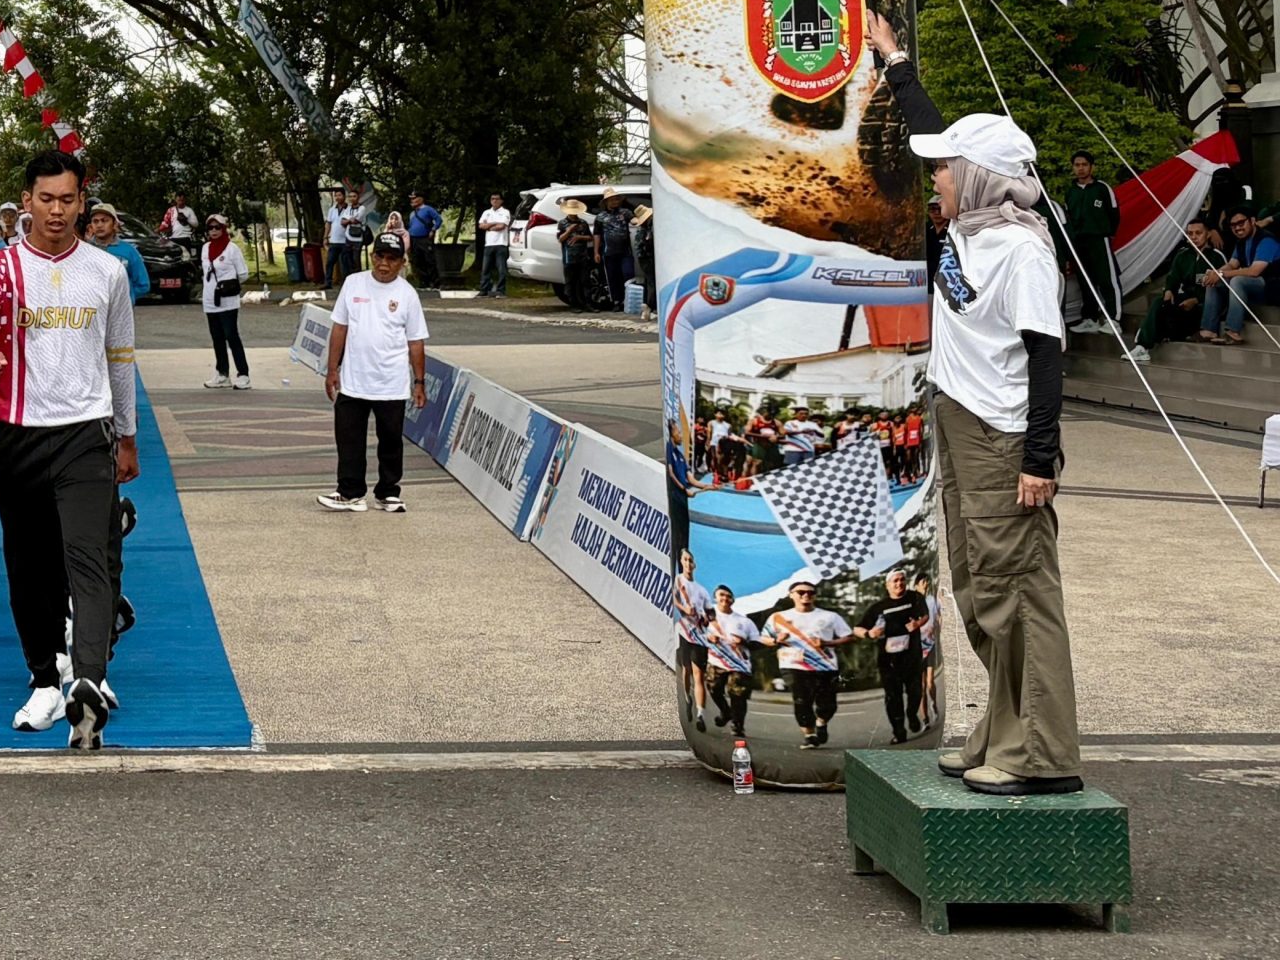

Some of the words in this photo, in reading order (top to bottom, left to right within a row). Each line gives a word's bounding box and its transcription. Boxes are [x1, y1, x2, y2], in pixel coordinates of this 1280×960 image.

[812, 267, 910, 283] KALSEL
[16, 306, 97, 329] DISHUT
[571, 513, 607, 560] KALAH
